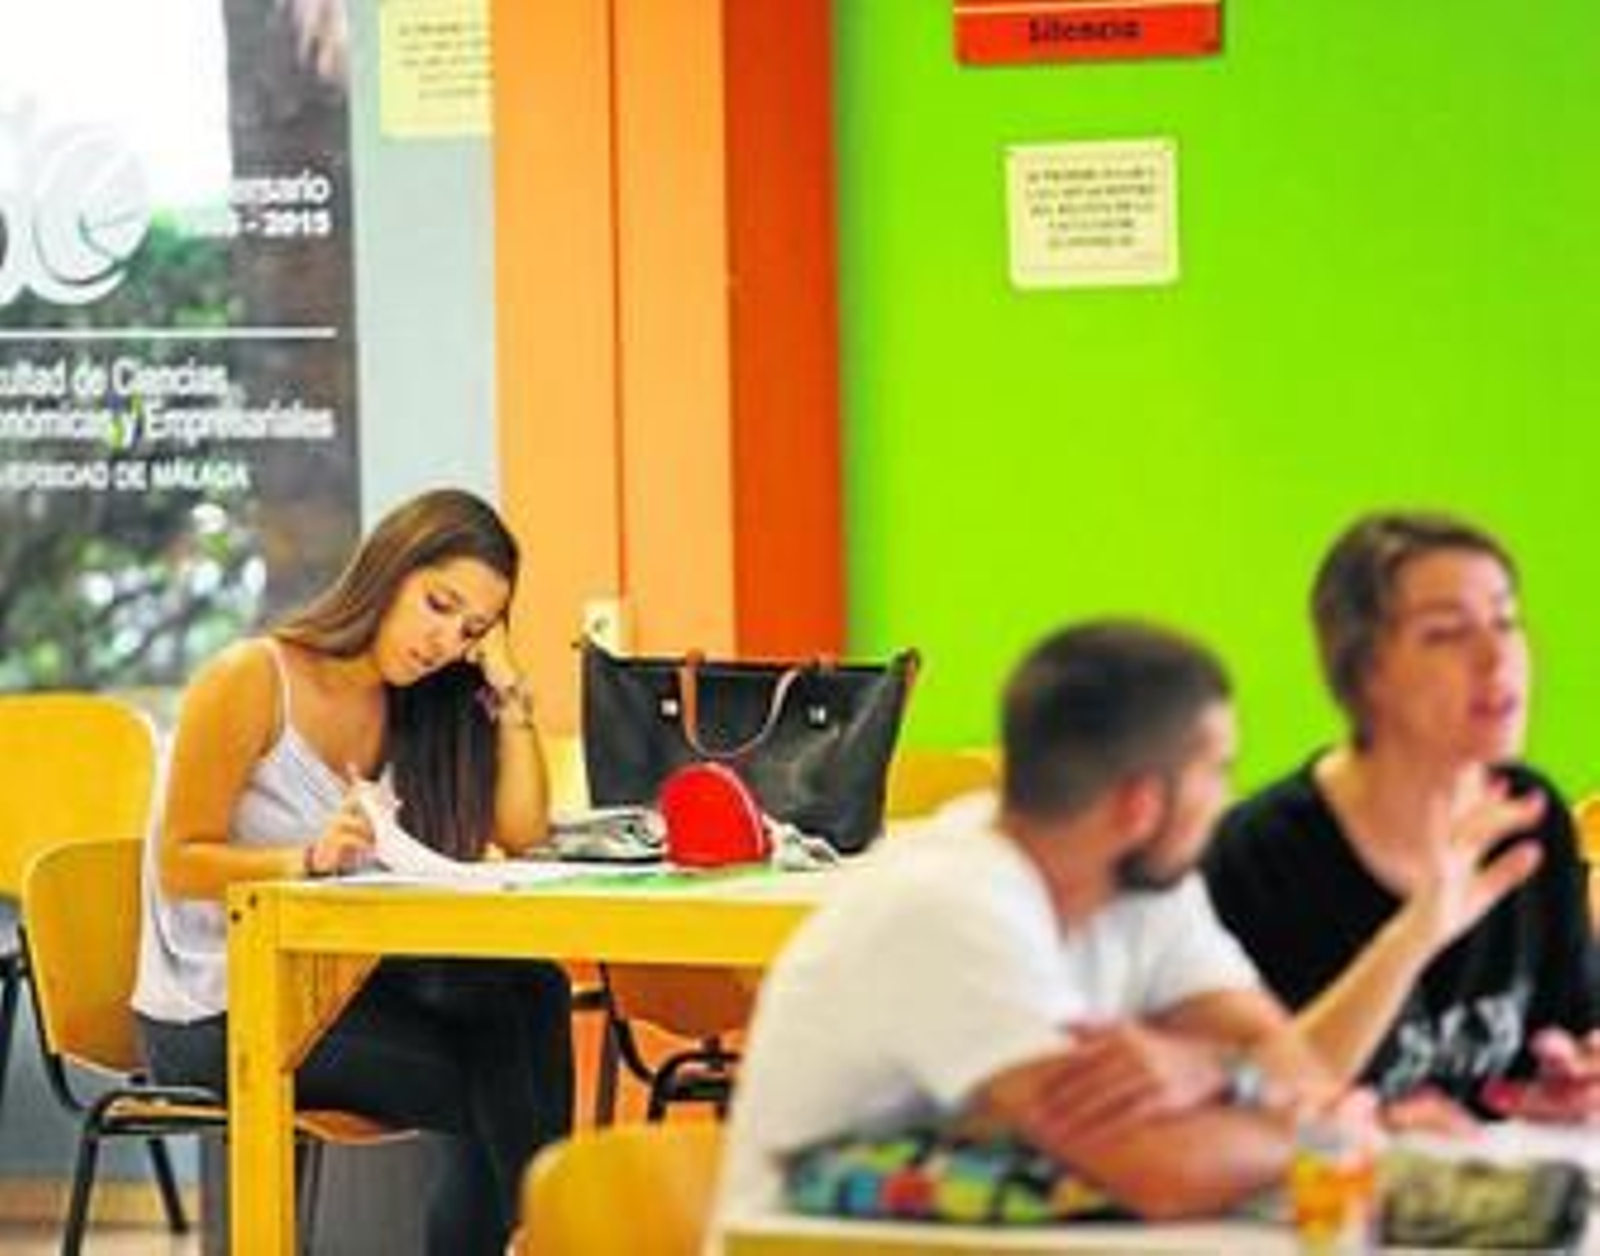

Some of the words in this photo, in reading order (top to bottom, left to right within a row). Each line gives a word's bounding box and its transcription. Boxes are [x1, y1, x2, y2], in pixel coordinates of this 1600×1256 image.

[229, 170, 332, 204] ersario
[72, 357, 107, 394] de
[112, 356, 228, 396] Ciencias
[144, 400, 335, 445] Empresariales
[113, 460, 147, 490] DE
